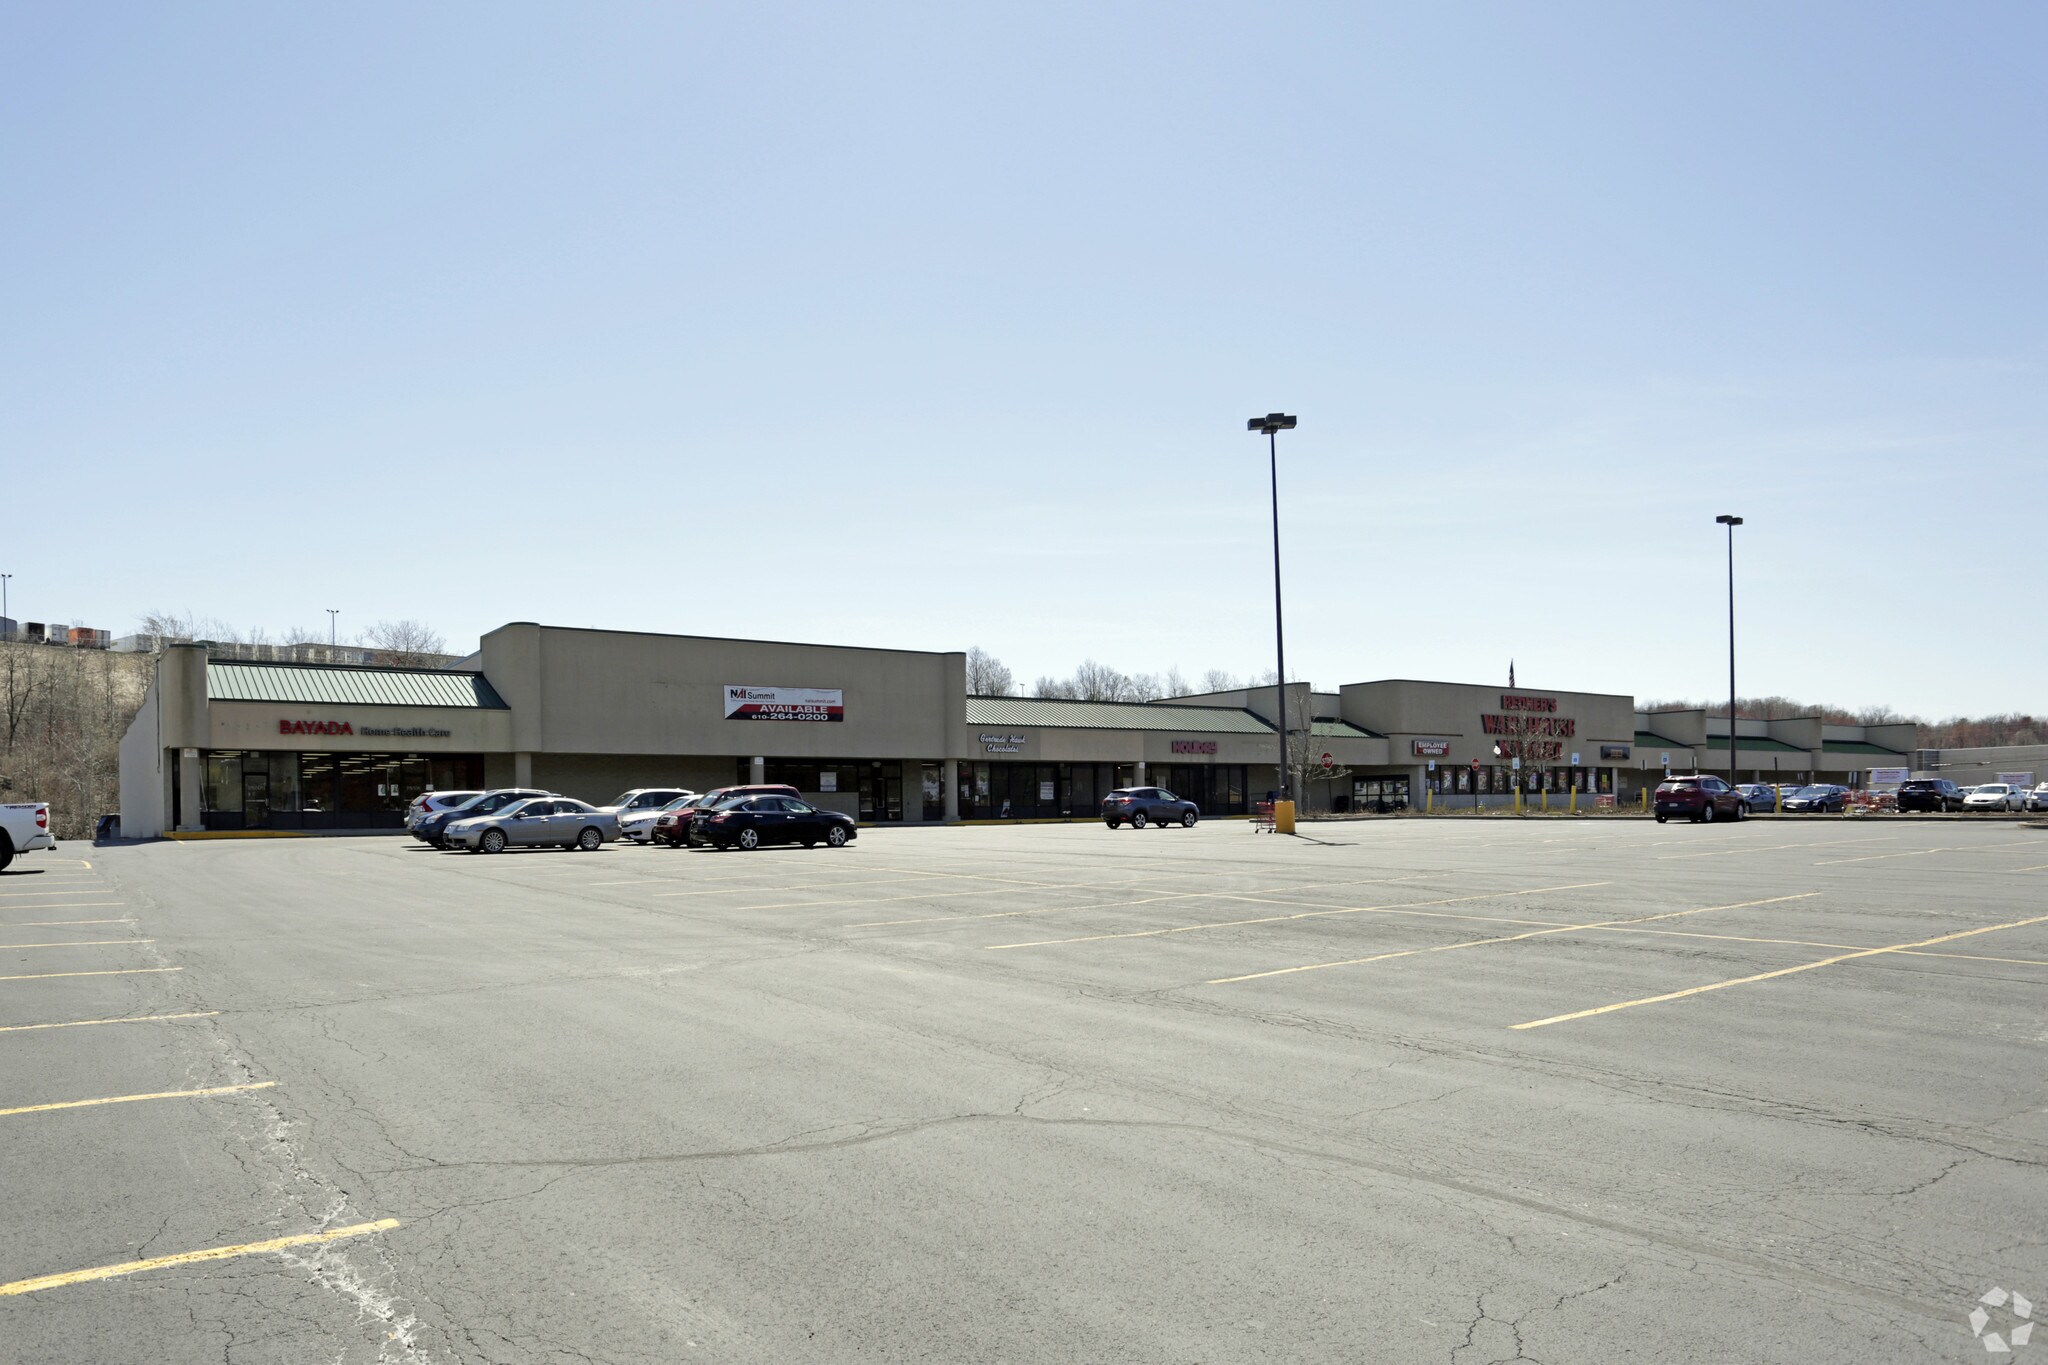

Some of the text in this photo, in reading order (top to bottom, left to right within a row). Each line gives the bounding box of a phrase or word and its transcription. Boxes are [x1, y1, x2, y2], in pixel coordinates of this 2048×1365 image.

[730, 688, 775, 700] NAI Summit
[760, 705, 828, 713] AVAILABLE
[1501, 695, 1558, 713] REDNER'S
[280, 720, 451, 737] BAYADA Home Health Care
